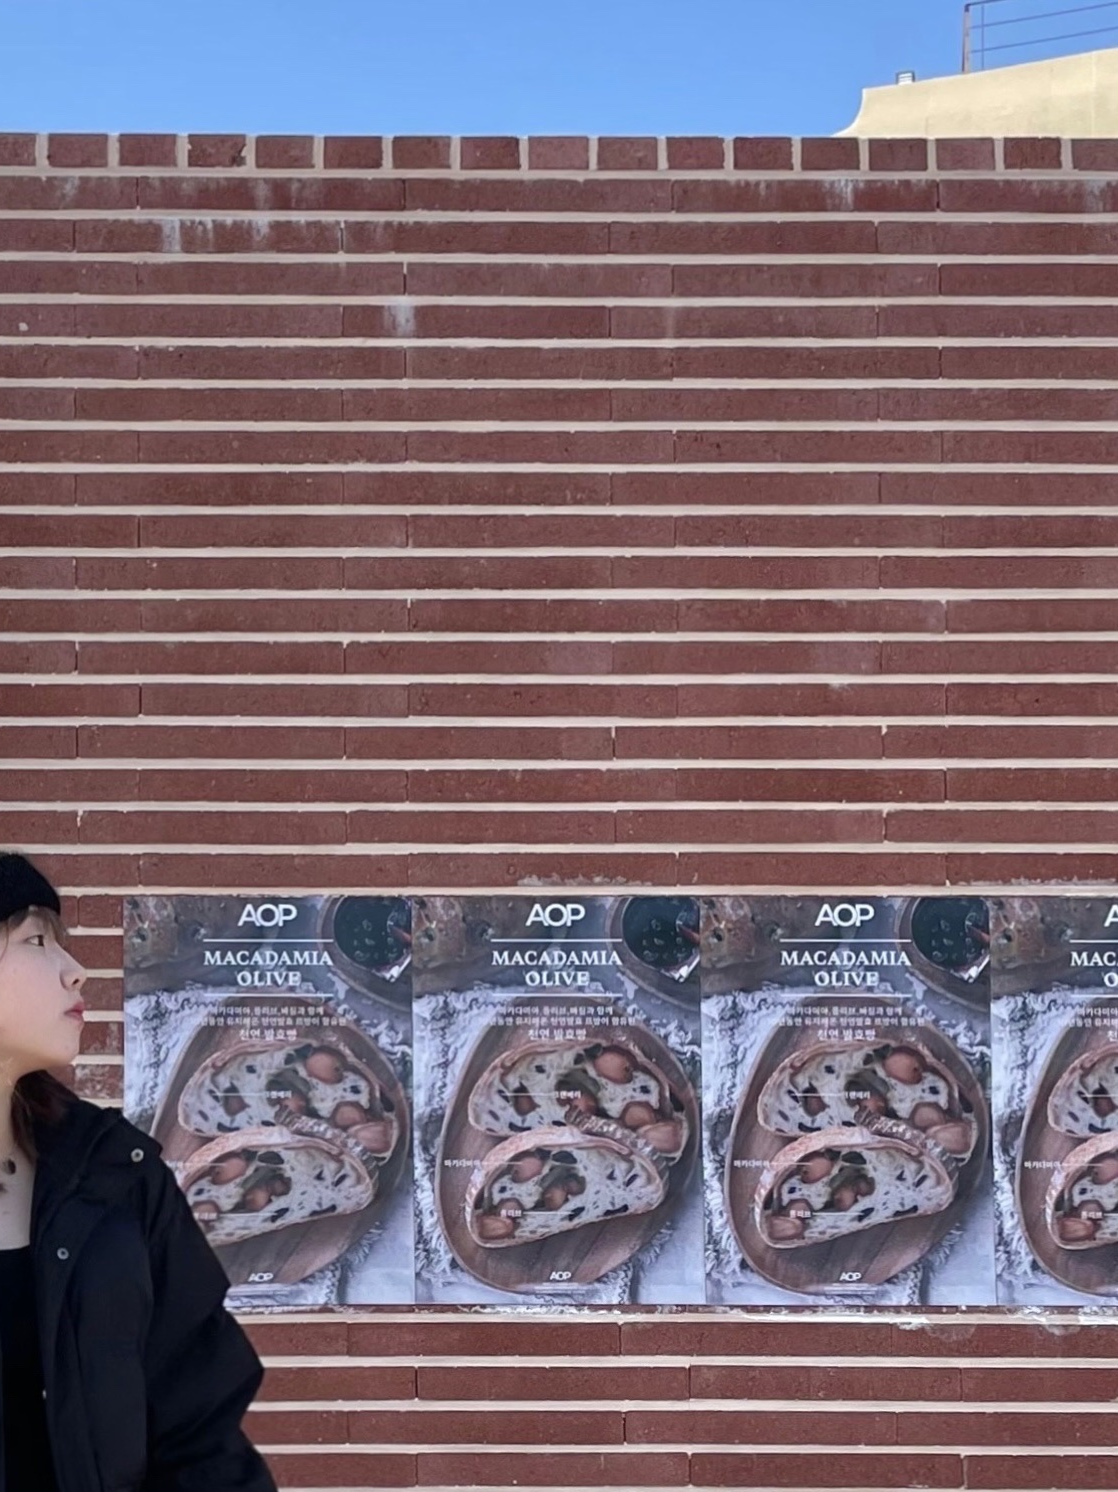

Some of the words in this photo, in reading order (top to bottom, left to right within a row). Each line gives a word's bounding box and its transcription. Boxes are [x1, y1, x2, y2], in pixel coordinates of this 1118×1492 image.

[237, 904, 297, 926] AOP
[525, 904, 585, 926] AOP
[814, 904, 875, 926] AOP
[203, 951, 334, 965] MACADAMIA
[491, 951, 623, 965] MACADAMIA
[780, 951, 912, 966] MACADAMIA
[1070, 951, 1118, 967] MAC
[237, 971, 301, 986] OLIVE
[525, 971, 590, 986] OLIVE
[814, 971, 880, 986] OLIVE
[248, 1272, 274, 1282] AOP
[549, 1271, 572, 1281] AOP
[839, 1272, 862, 1282] AOP
